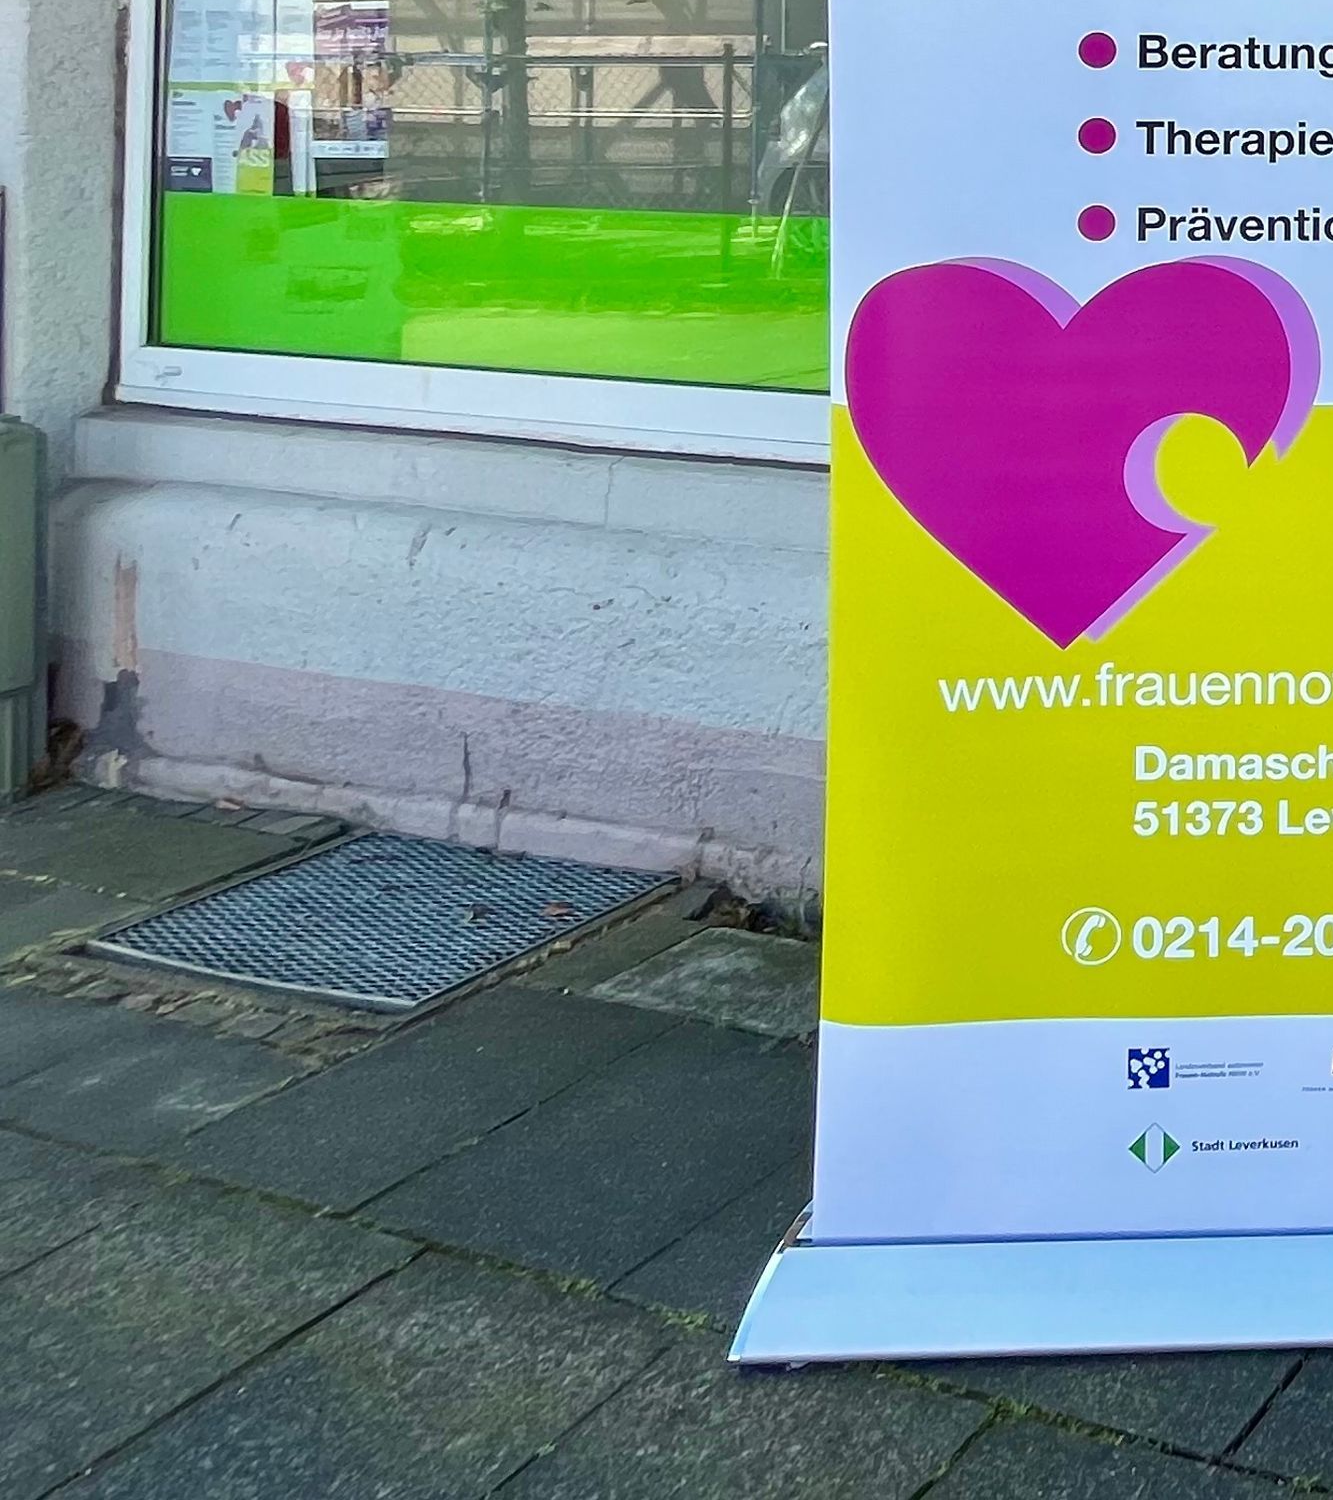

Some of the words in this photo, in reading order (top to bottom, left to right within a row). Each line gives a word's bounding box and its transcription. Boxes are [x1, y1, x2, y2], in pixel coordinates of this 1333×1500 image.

[1132, 801, 1264, 837] 51373
[1191, 1139, 1224, 1153] Stadt
[1229, 1137, 1299, 1152] Leverkusen
